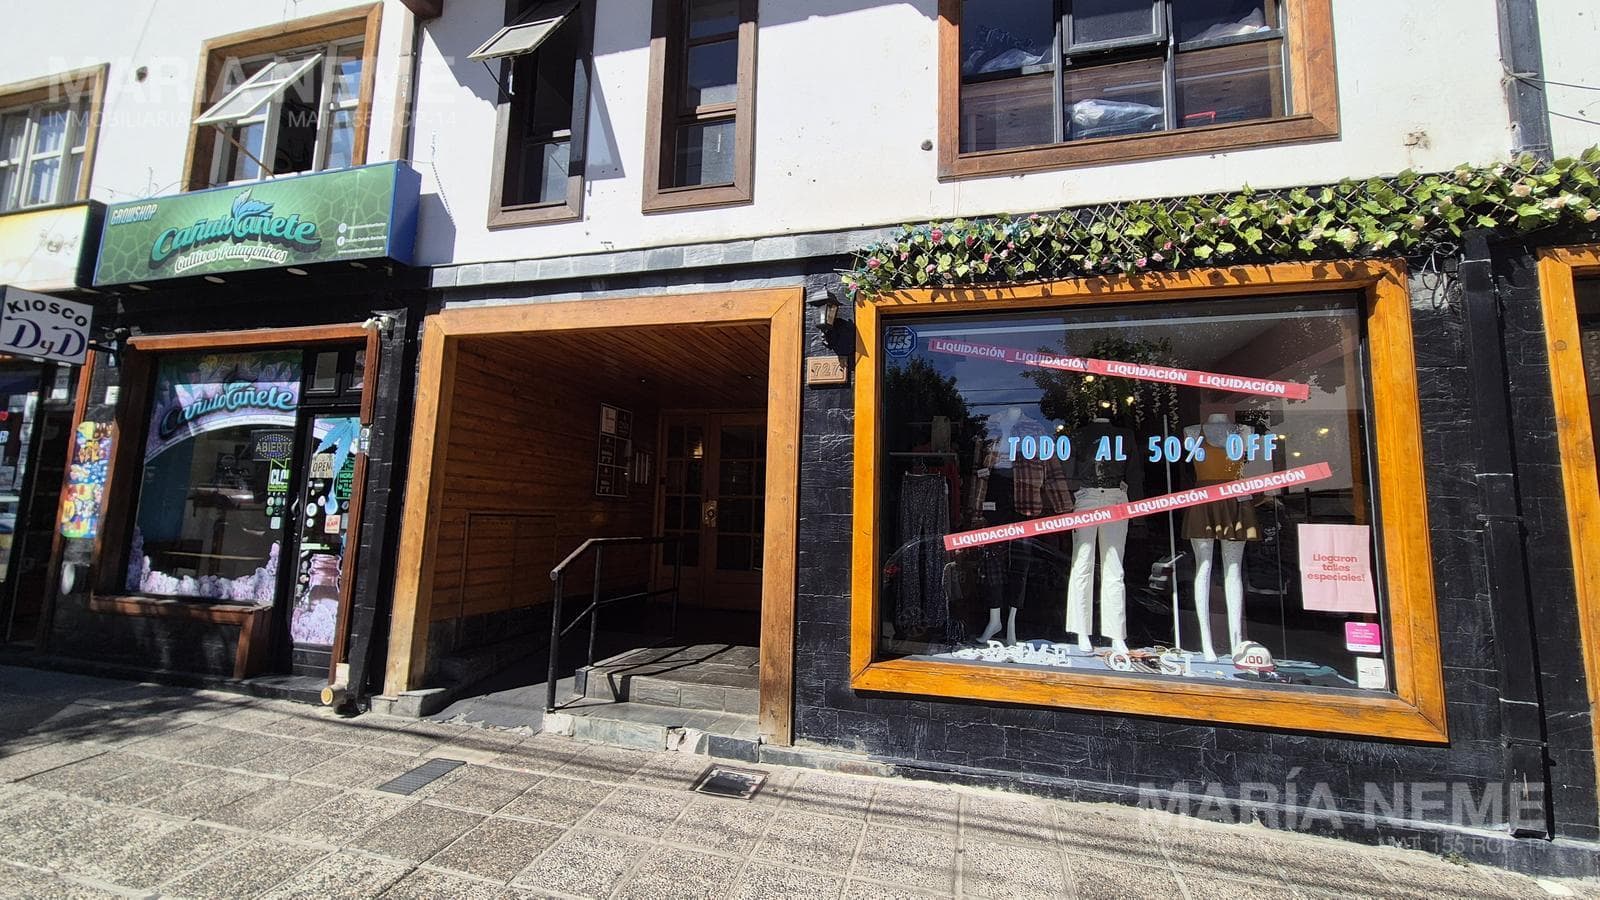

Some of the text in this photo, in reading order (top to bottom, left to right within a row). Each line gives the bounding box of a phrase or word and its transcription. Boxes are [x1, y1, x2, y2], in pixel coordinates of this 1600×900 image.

[111, 204, 158, 225] GROWSHOP
[175, 247, 219, 273] Cultivos
[7, 299, 88, 327] KIOSCO
[3, 316, 86, 356] DyD
[813, 362, 840, 377] 727
[936, 341, 1285, 395] LIQUIDACIÓN LIQUIDACIÓN LIQUIDACIÓN LIQUIDACIÓN
[1008, 433, 1278, 463] TODO AL 50% OFF
[312, 461, 332, 473] OPEN
[952, 469, 1306, 547] LIQUIDACIÓN LIQUIDACIÓN LIQUIDACIÓN LIQUIDACIÓN
[1312, 553, 1358, 564] Llegaron
[1322, 562, 1351, 572] talles
[1307, 572, 1366, 583] especiales!
